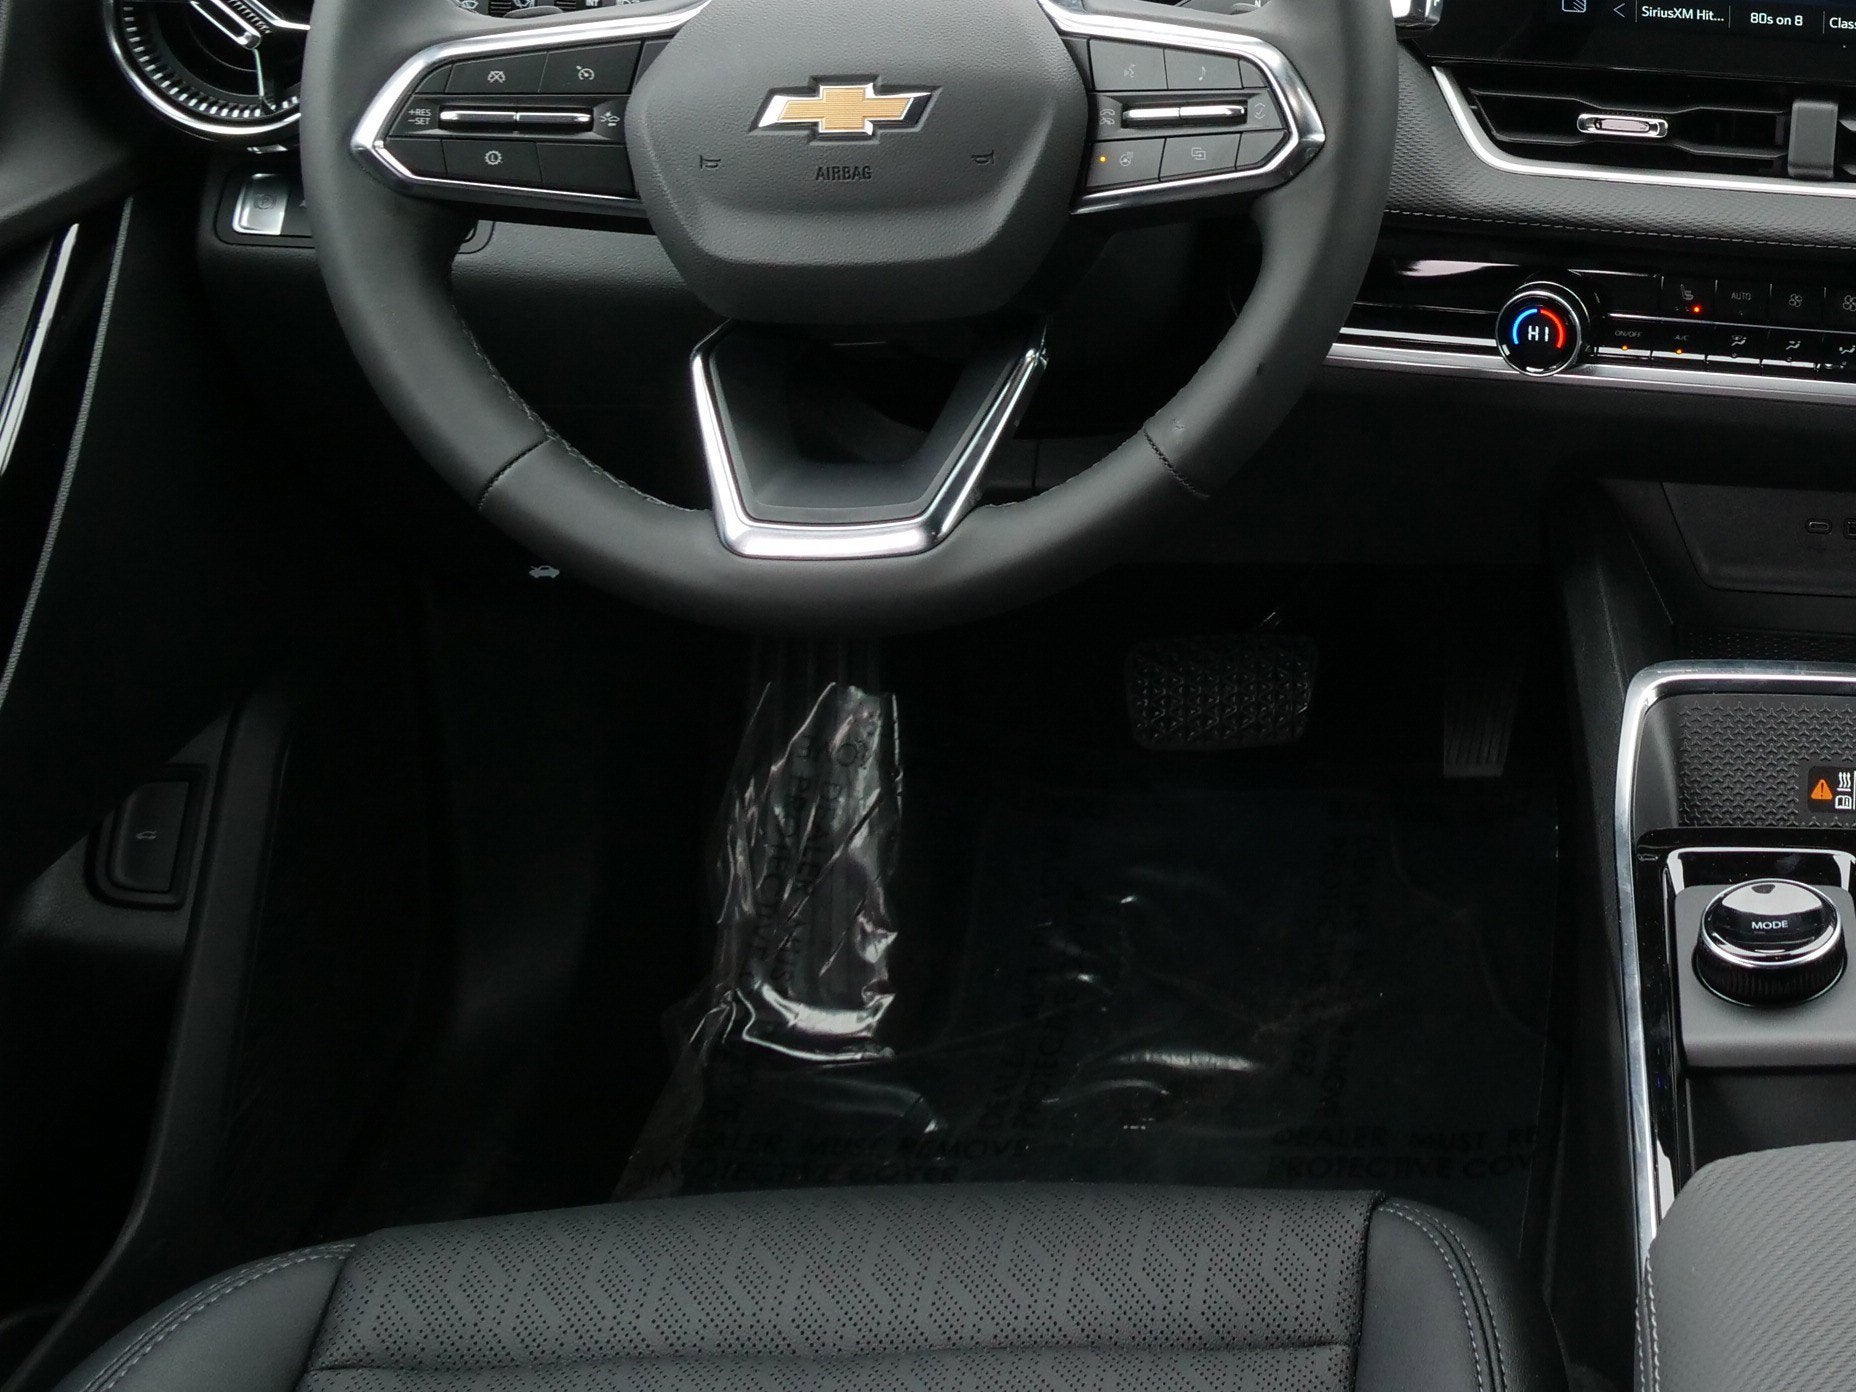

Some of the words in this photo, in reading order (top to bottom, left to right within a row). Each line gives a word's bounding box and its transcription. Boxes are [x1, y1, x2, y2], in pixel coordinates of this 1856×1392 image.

[586, 0, 599, 7] INT
[1642, 6, 1694, 20] SiriusXM
[1697, 9, 1725, 23] Hit...
[1751, 12, 1775, 26] 80s
[1777, 16, 1792, 27] on
[1795, 15, 1805, 28] 8
[815, 166, 873, 181] AIRBAG
[1731, 291, 1753, 302] AUTO
[1528, 324, 1550, 343] HI
[1614, 330, 1642, 340] ON/OFF
[1675, 335, 1690, 344] A/C
[1751, 920, 1789, 930] MODE
